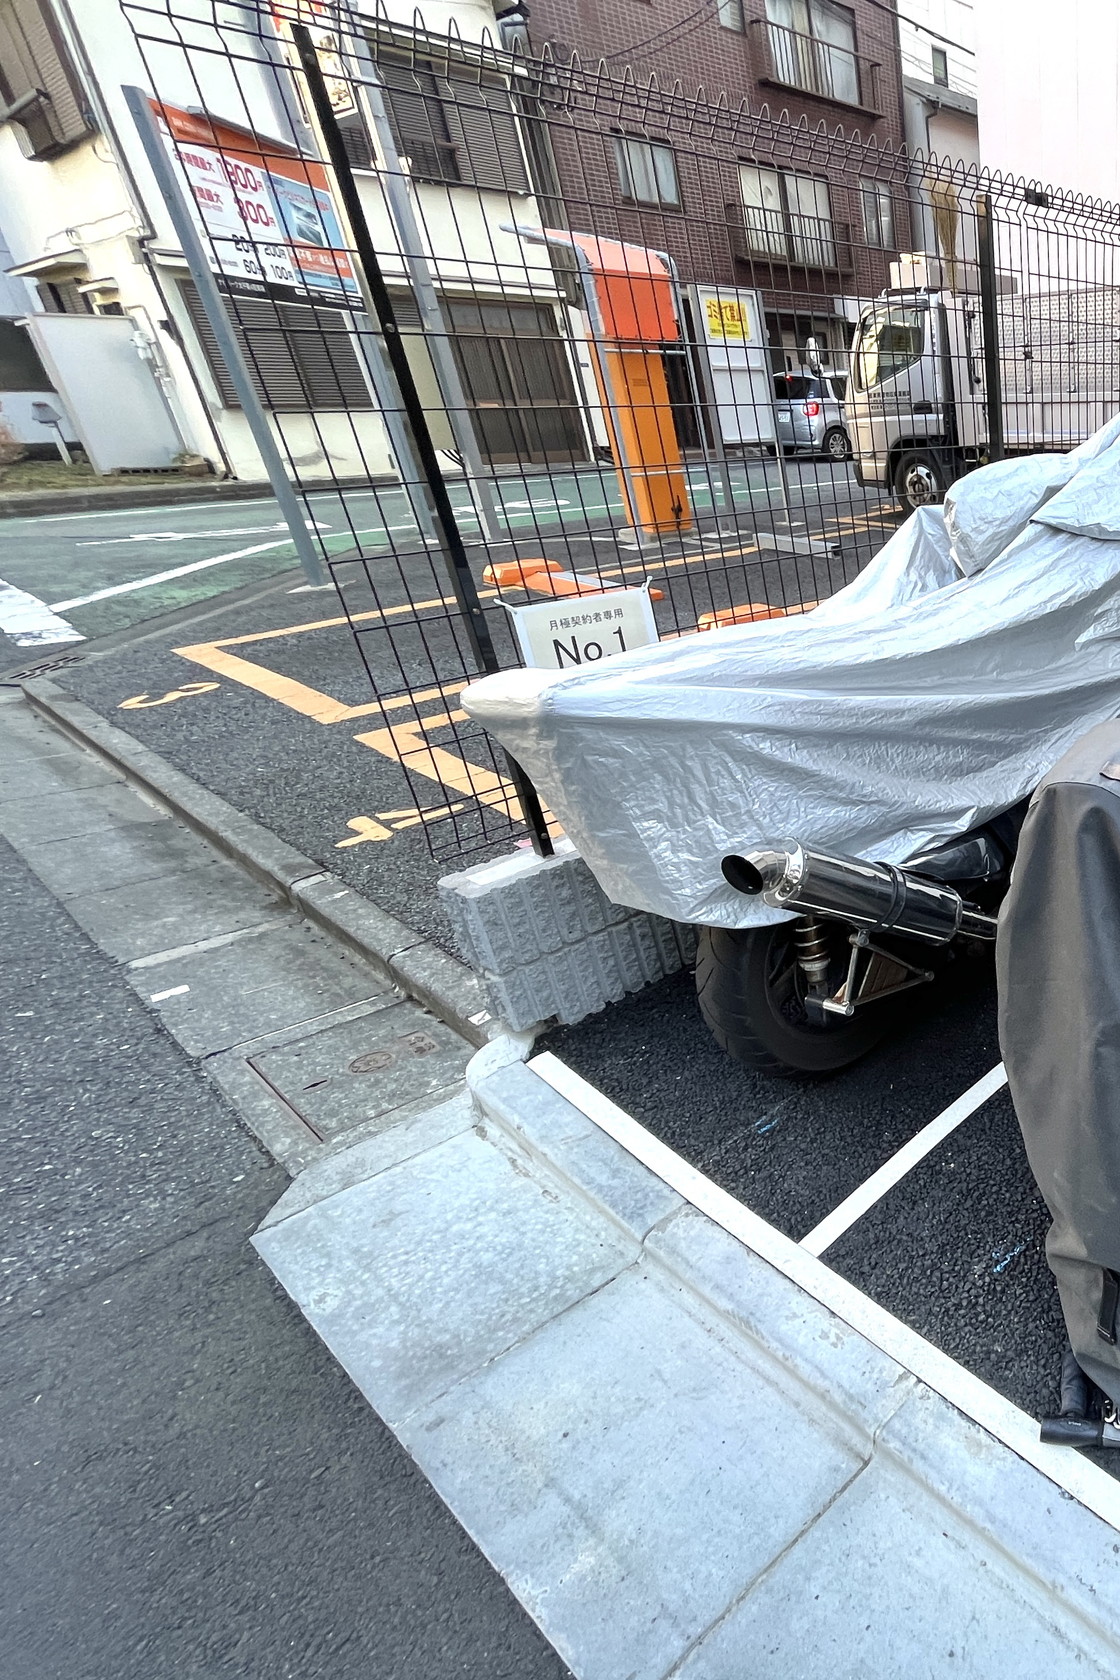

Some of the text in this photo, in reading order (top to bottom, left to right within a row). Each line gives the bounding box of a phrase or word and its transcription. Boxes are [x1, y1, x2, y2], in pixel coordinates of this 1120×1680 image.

[549, 608, 624, 631] 月極契約者専用
